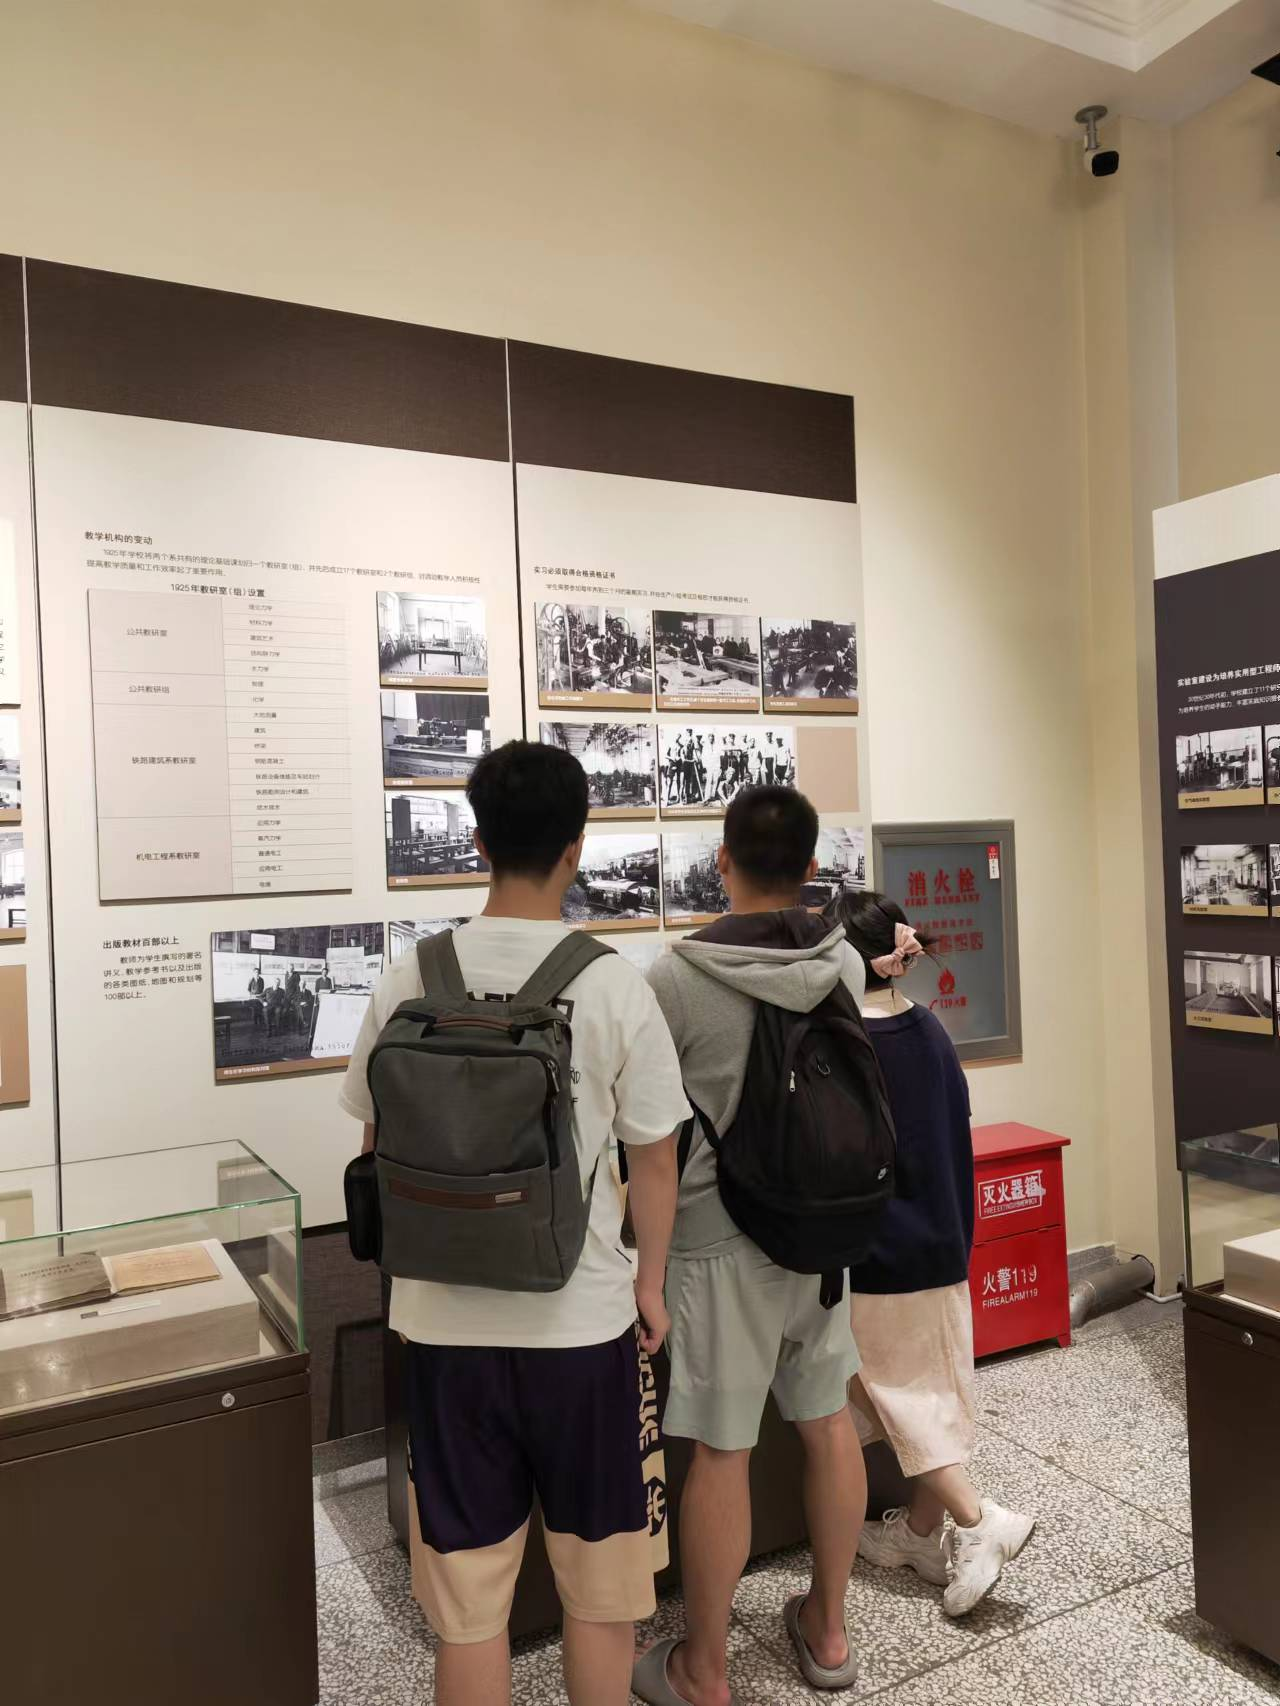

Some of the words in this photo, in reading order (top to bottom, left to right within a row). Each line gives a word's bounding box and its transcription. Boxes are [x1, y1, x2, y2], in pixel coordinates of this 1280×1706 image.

[84, 531, 153, 545] 教学机构的变动
[126, 628, 168, 637] 公共教研室
[128, 685, 170, 694] 公共教研组
[131, 756, 196, 765] 铁路建筑系教研室
[136, 852, 200, 861] 机电工程系教研室
[908, 867, 976, 897] 消火栓
[102, 936, 179, 950] 出版教材百部以上
[983, 1175, 1043, 1207] 灭火器箱
[982, 1264, 1038, 1296] 火警119
